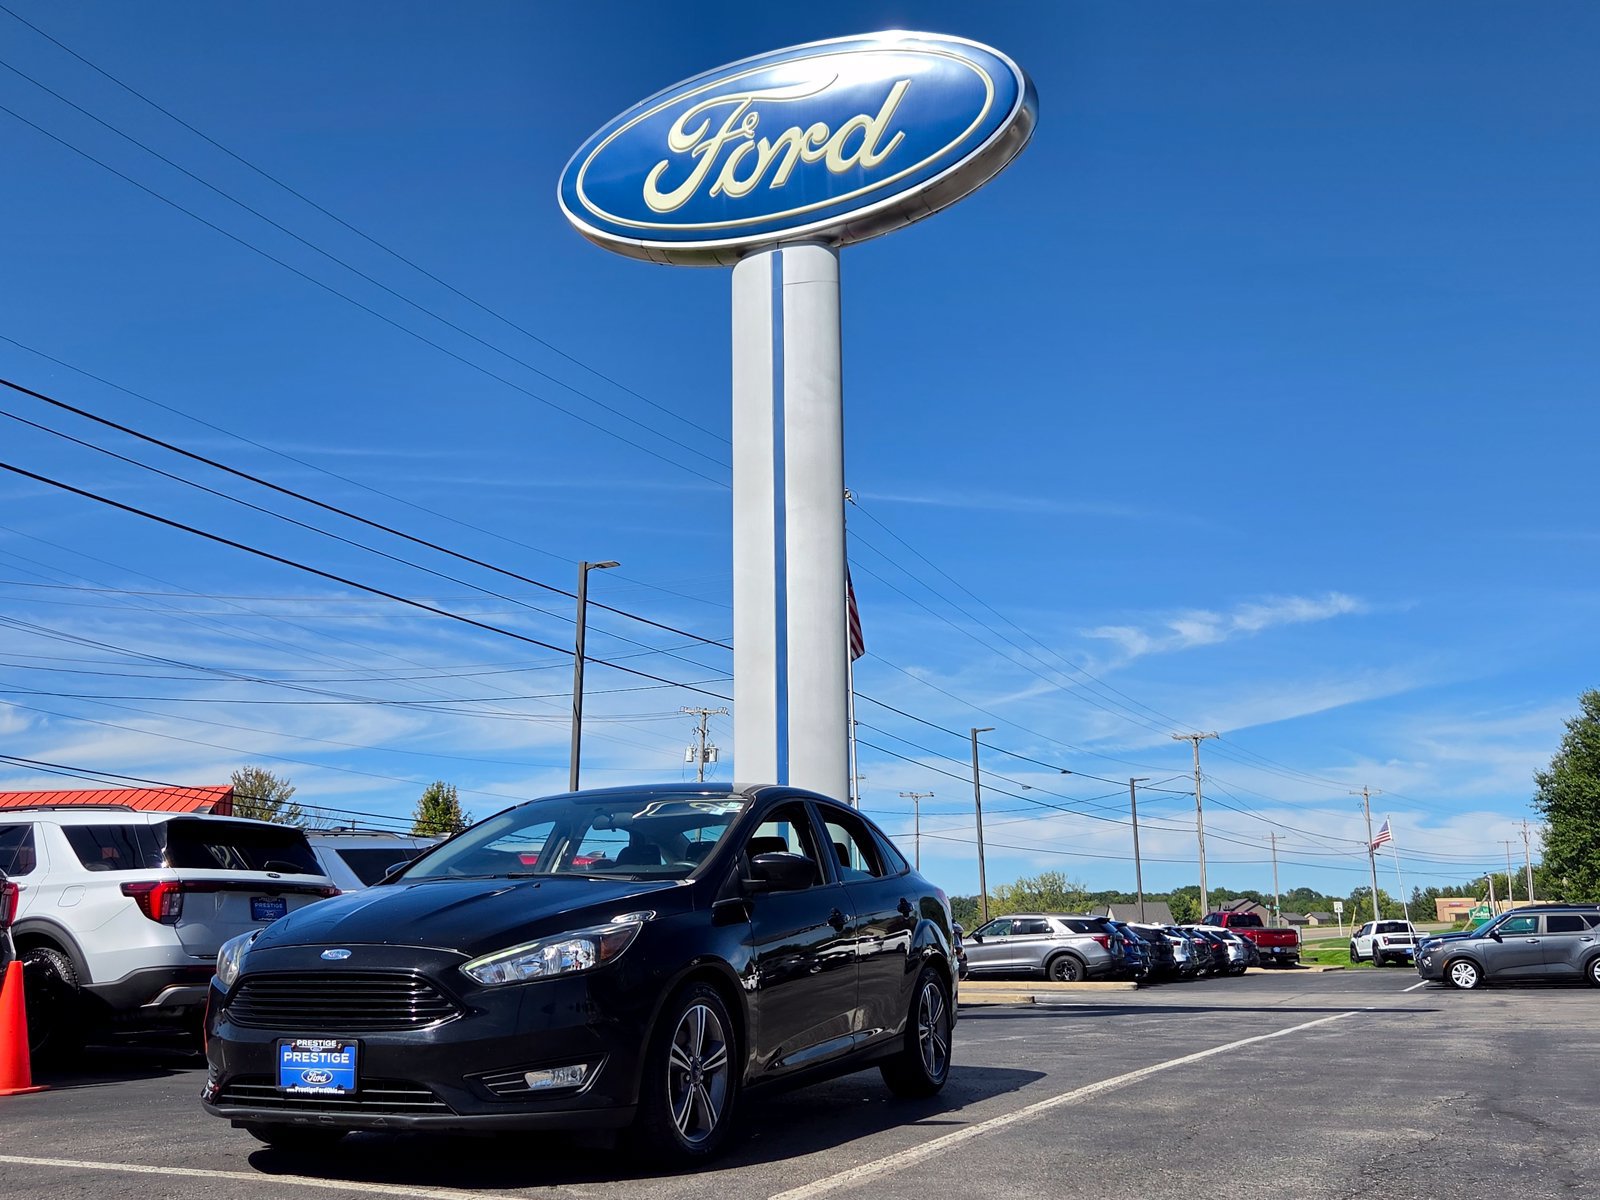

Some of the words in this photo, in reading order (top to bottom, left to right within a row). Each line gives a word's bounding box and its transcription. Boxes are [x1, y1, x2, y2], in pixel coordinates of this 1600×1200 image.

[643, 73, 912, 213] Ford
[284, 1052, 350, 1063] PRESTIGE
[306, 1070, 327, 1082] Ford
